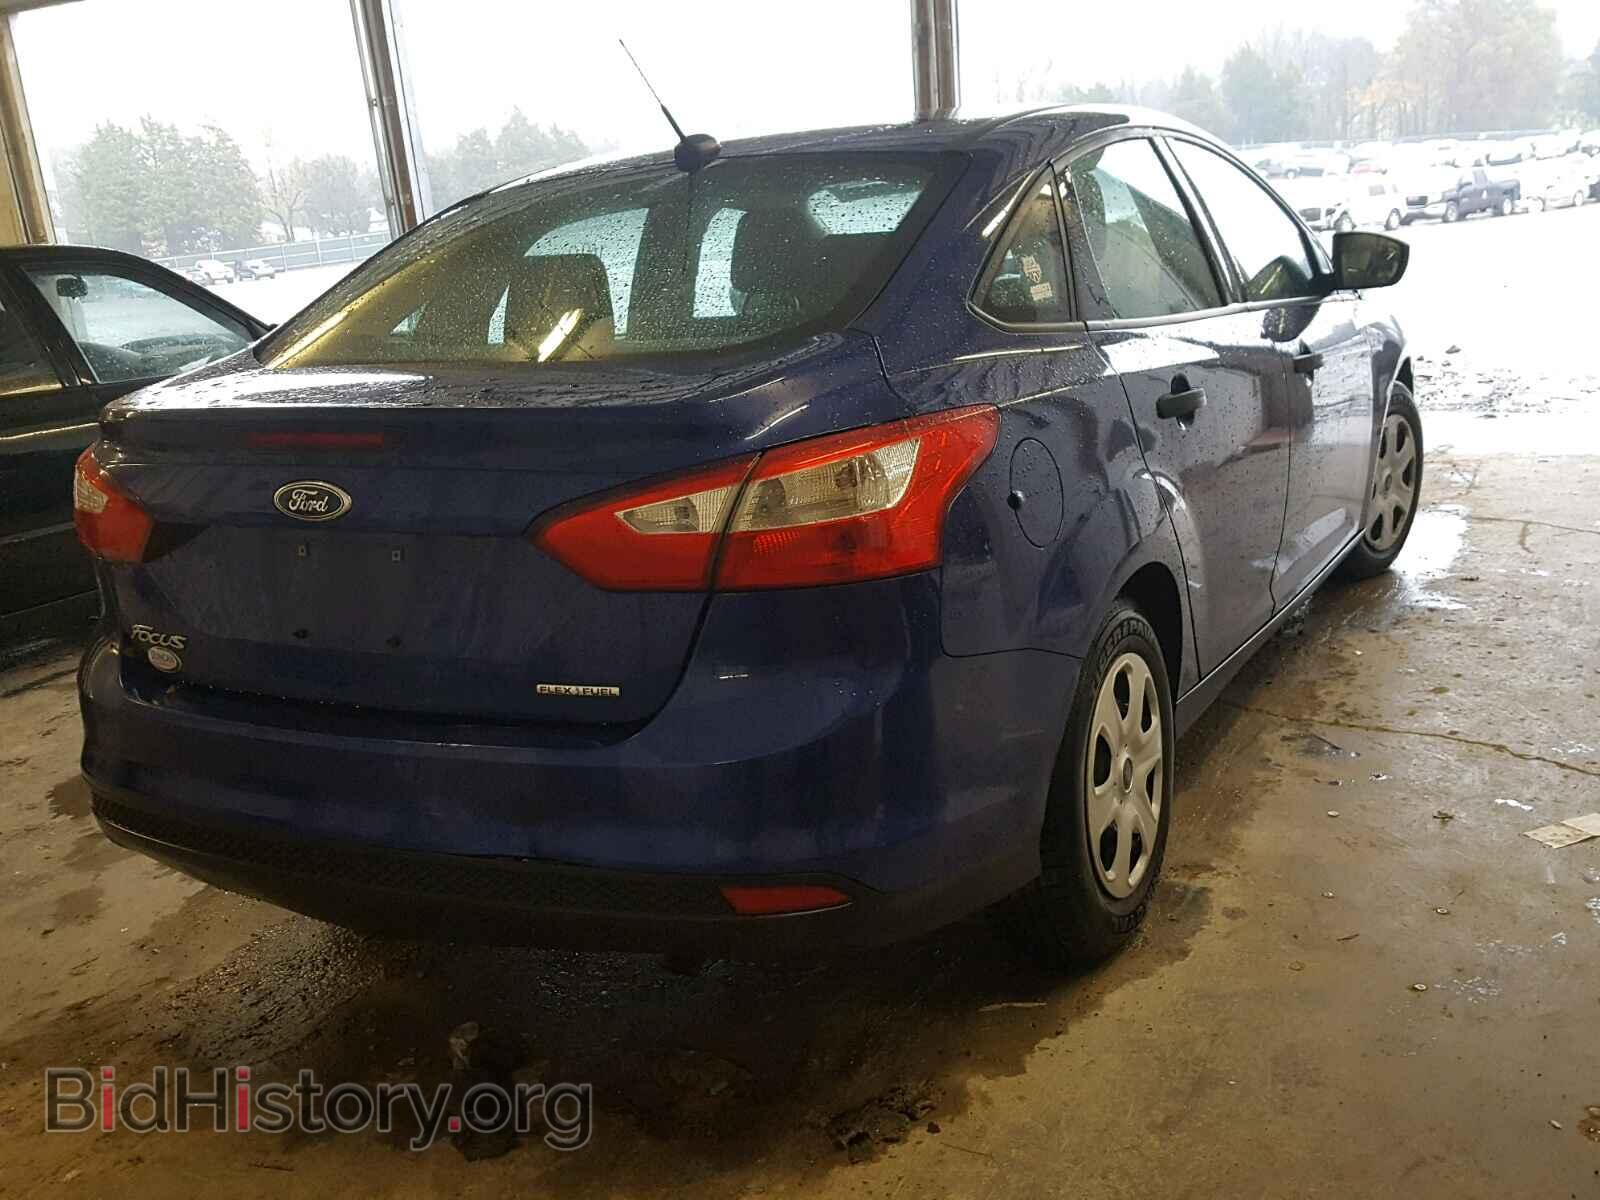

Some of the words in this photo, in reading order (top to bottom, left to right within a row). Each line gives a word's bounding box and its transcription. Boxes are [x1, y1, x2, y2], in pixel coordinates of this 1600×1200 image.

[288, 488, 329, 512] Ford
[130, 623, 187, 649] FOCUS
[538, 685, 572, 695] FLEX
[582, 687, 617, 697] FUEL
